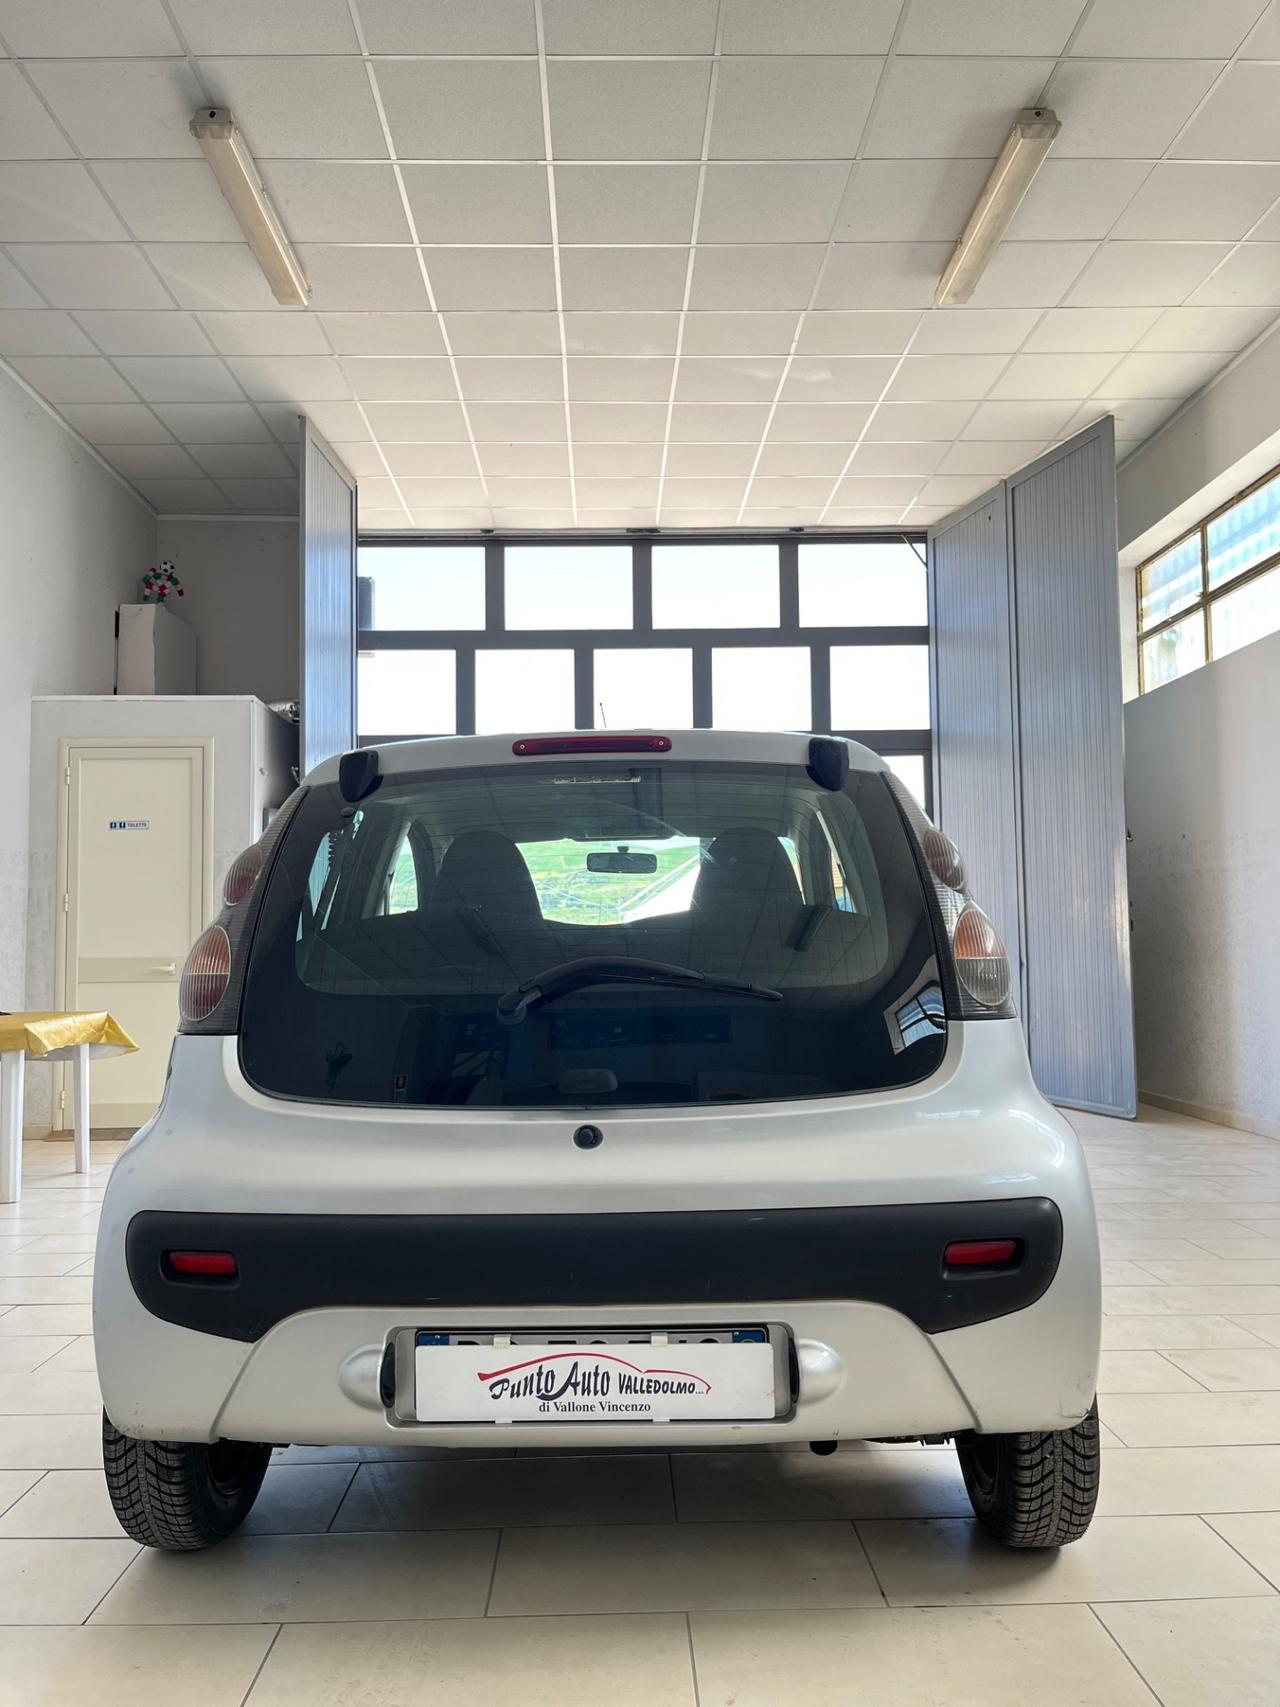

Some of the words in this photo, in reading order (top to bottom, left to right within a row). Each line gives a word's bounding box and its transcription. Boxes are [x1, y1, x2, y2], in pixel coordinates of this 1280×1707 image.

[489, 1364, 556, 1400] Punto
[535, 1361, 610, 1401] Auto
[539, 1401, 550, 1412] di
[553, 1401, 595, 1412] Vallone
[599, 1401, 651, 1412] Vincenzo
